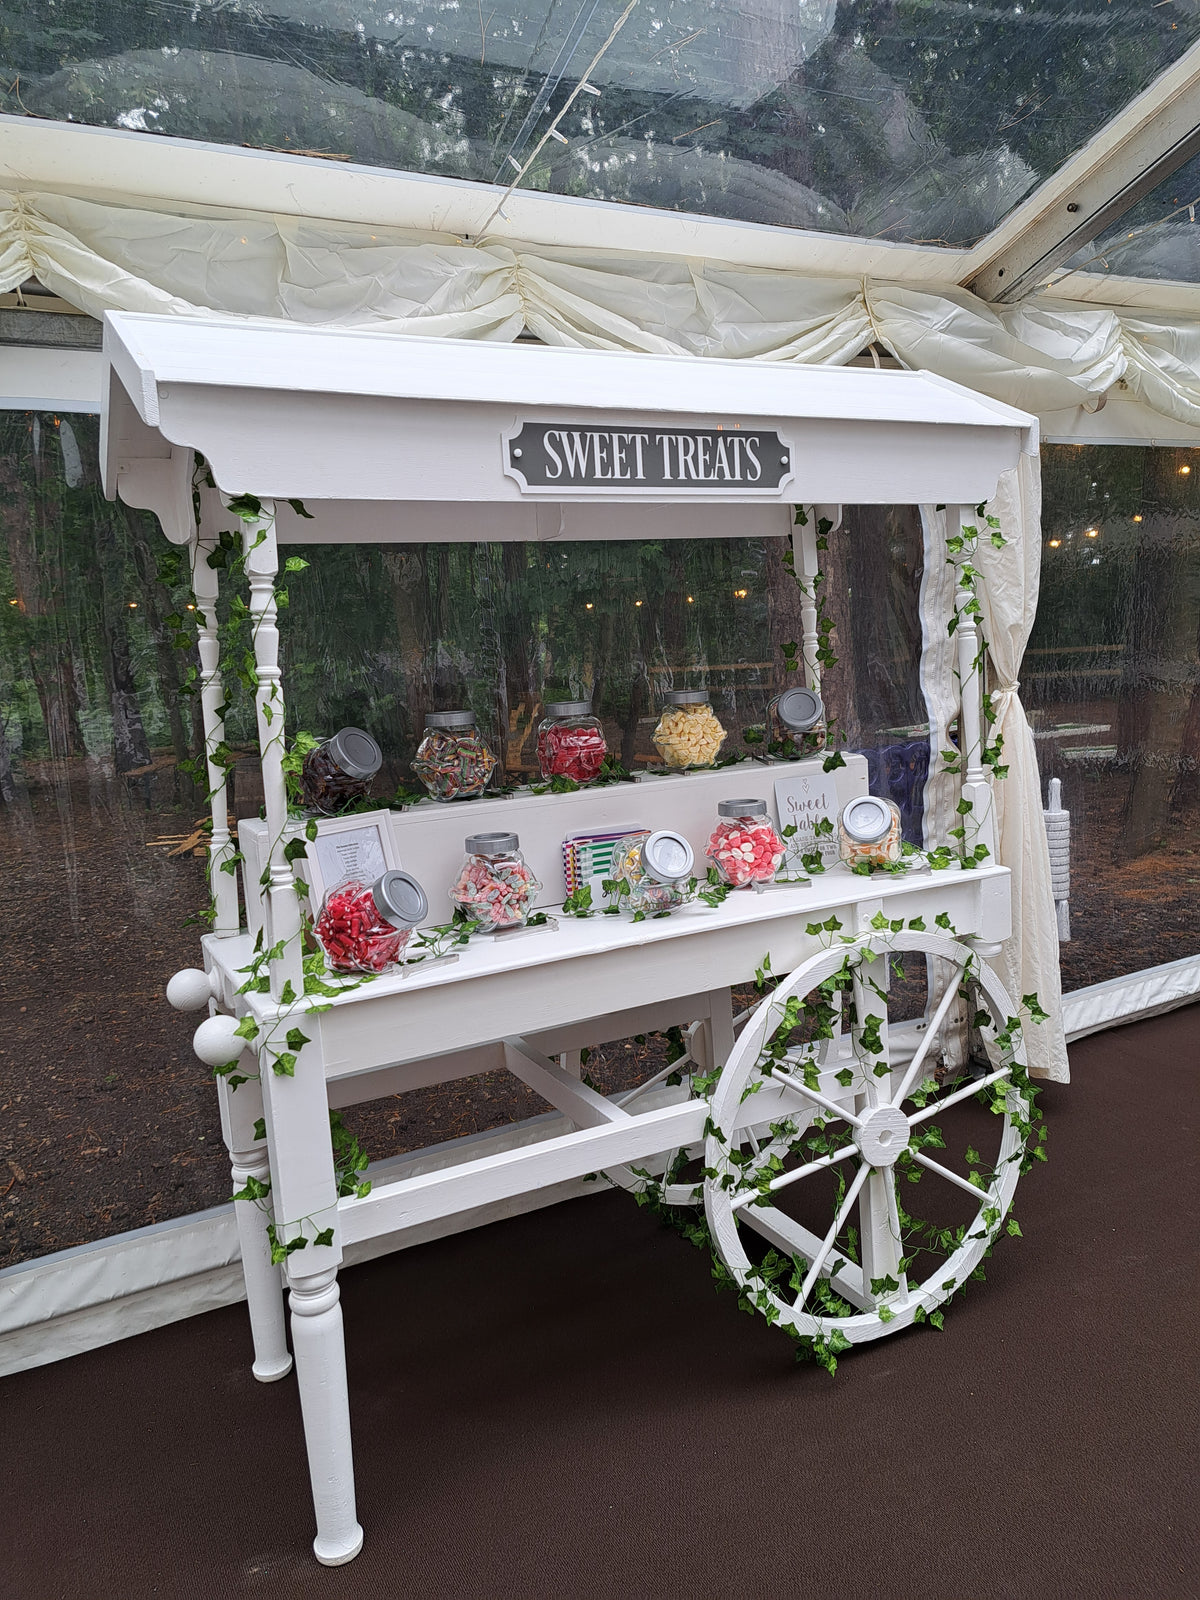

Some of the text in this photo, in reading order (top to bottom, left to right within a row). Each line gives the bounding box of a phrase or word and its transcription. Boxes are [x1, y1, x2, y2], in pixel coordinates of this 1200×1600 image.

[543, 430, 762, 481] SWEET TREATS
[787, 793, 829, 813] Sweet
